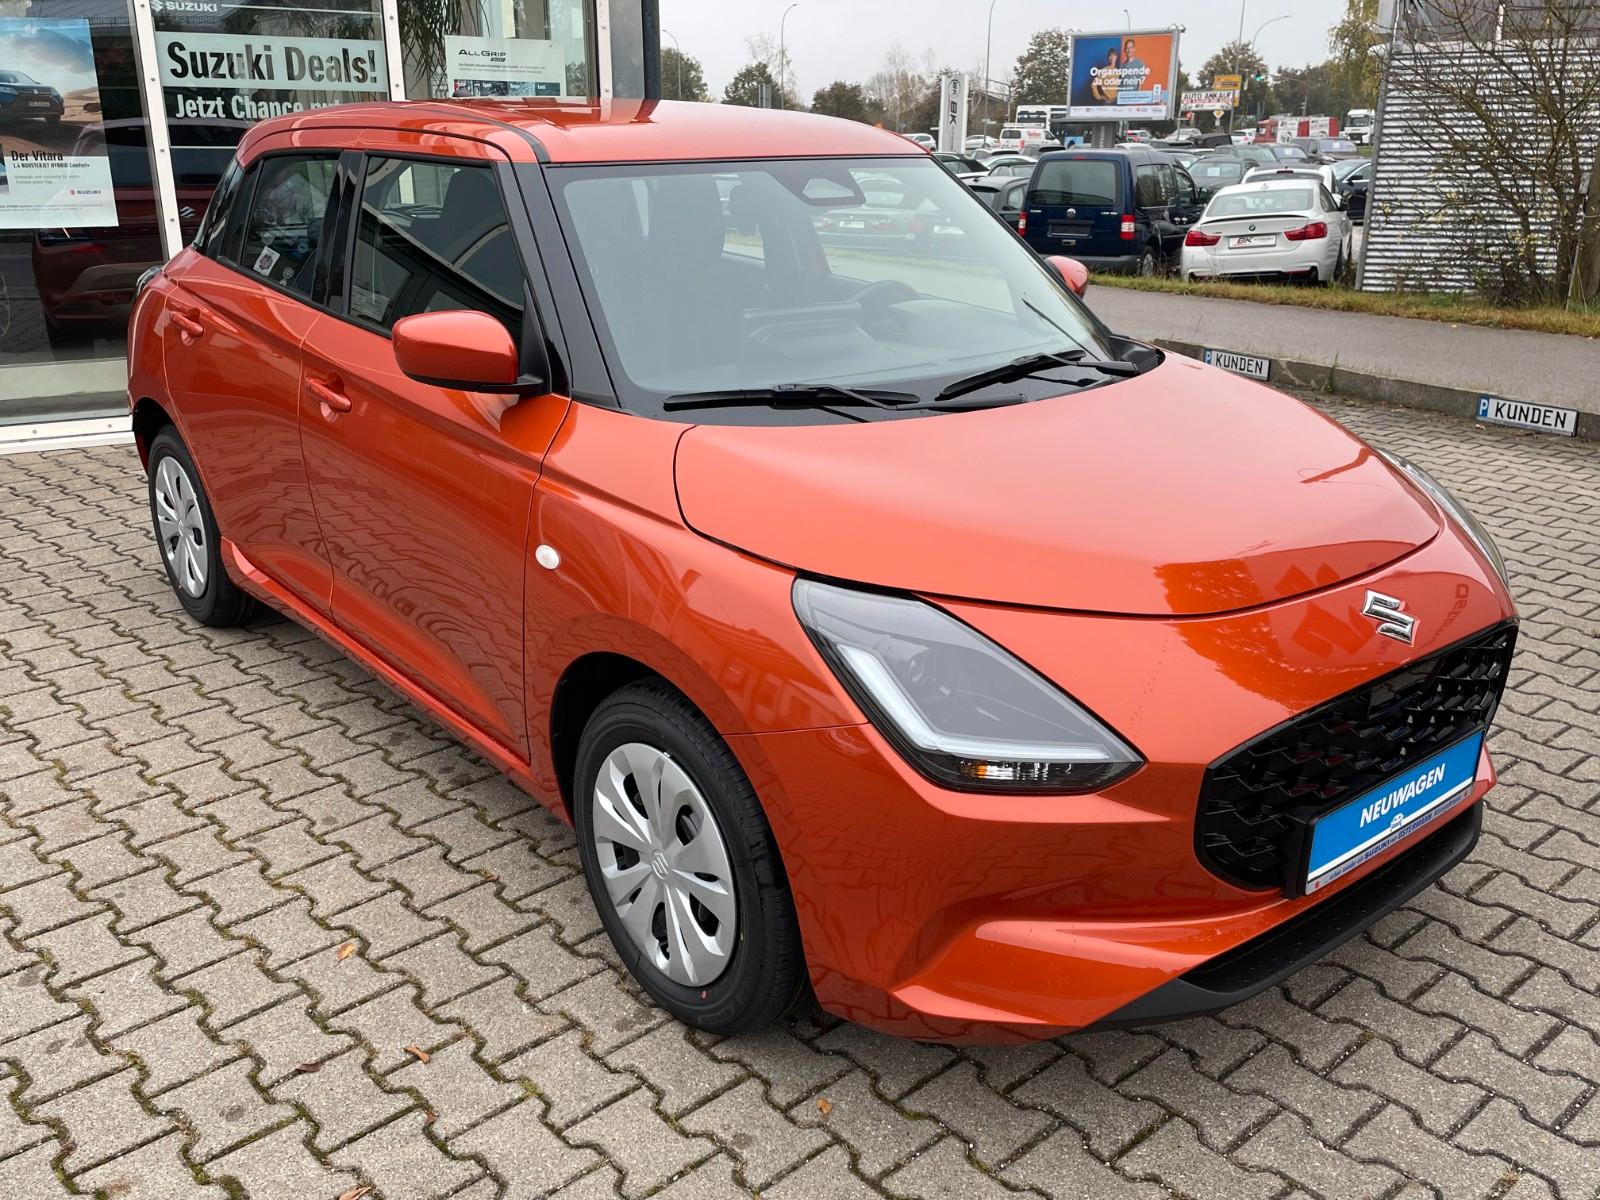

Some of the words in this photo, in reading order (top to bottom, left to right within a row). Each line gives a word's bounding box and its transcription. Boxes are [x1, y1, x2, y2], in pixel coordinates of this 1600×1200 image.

[165, 1, 218, 12] SUZUKI
[167, 41, 275, 81] Suzuki
[284, 46, 378, 84] Deals!
[1089, 66, 1151, 78] Organspende
[1093, 77, 1102, 86] Ja
[1104, 77, 1122, 86] oder
[1123, 76, 1146, 85] nein?
[1204, 91, 1231, 99] ANKAUF
[175, 94, 226, 119] Jetzt
[231, 95, 305, 119] Chance
[950, 101, 957, 125] BK
[10, 150, 29, 161] Der
[31, 150, 64, 161] Vitara
[1237, 236, 1254, 244] BK
[1215, 353, 1263, 375] KUNDEN
[1479, 398, 1488, 416] P
[1494, 402, 1567, 429] KUNDEN
[1359, 763, 1446, 828] NEUWAGEN
[1364, 840, 1390, 859] SUZUKI
